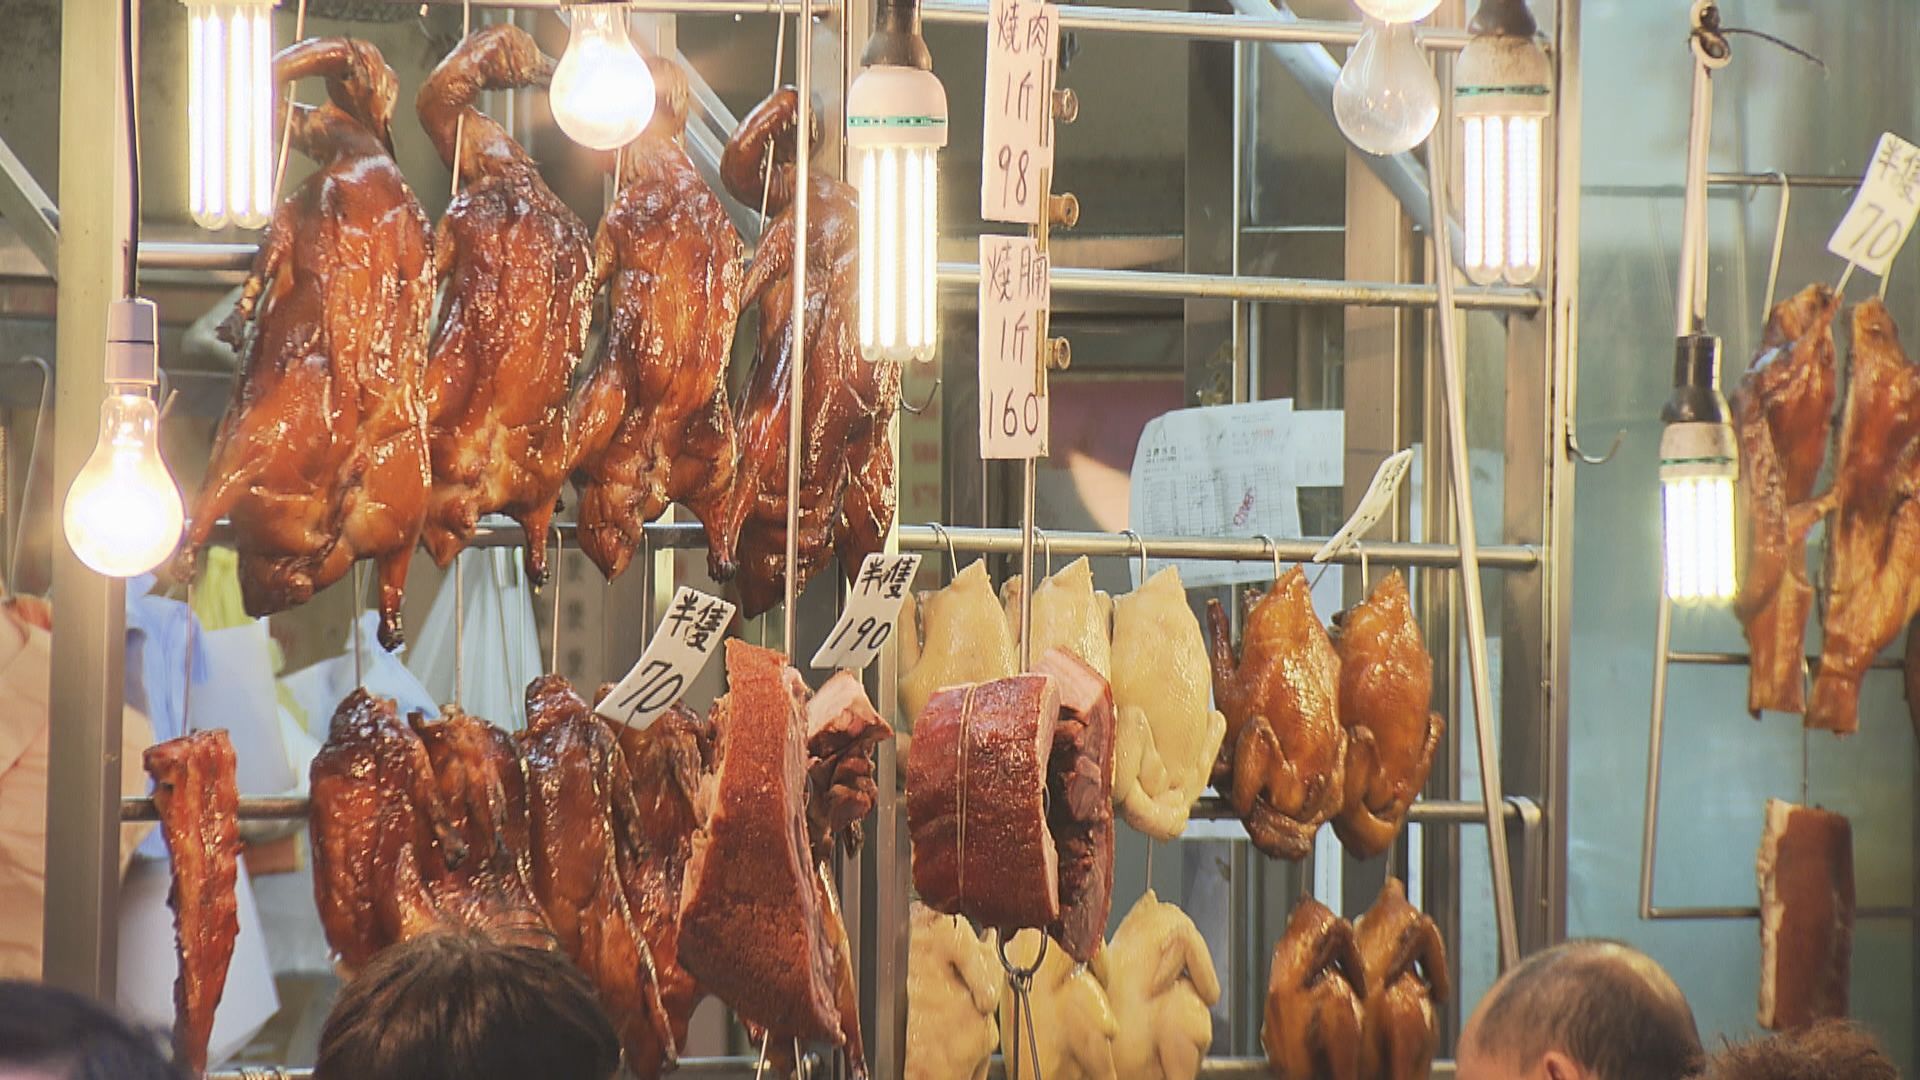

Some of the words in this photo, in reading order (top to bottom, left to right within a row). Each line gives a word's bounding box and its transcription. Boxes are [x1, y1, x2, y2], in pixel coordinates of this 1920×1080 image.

[999, 145, 1030, 209] 98
[1850, 202, 1903, 260] 70
[988, 388, 1039, 439] 160
[860, 556, 917, 600] 半隻
[669, 590, 729, 653] 半隻
[829, 616, 892, 652] 190
[618, 659, 684, 714] 70
